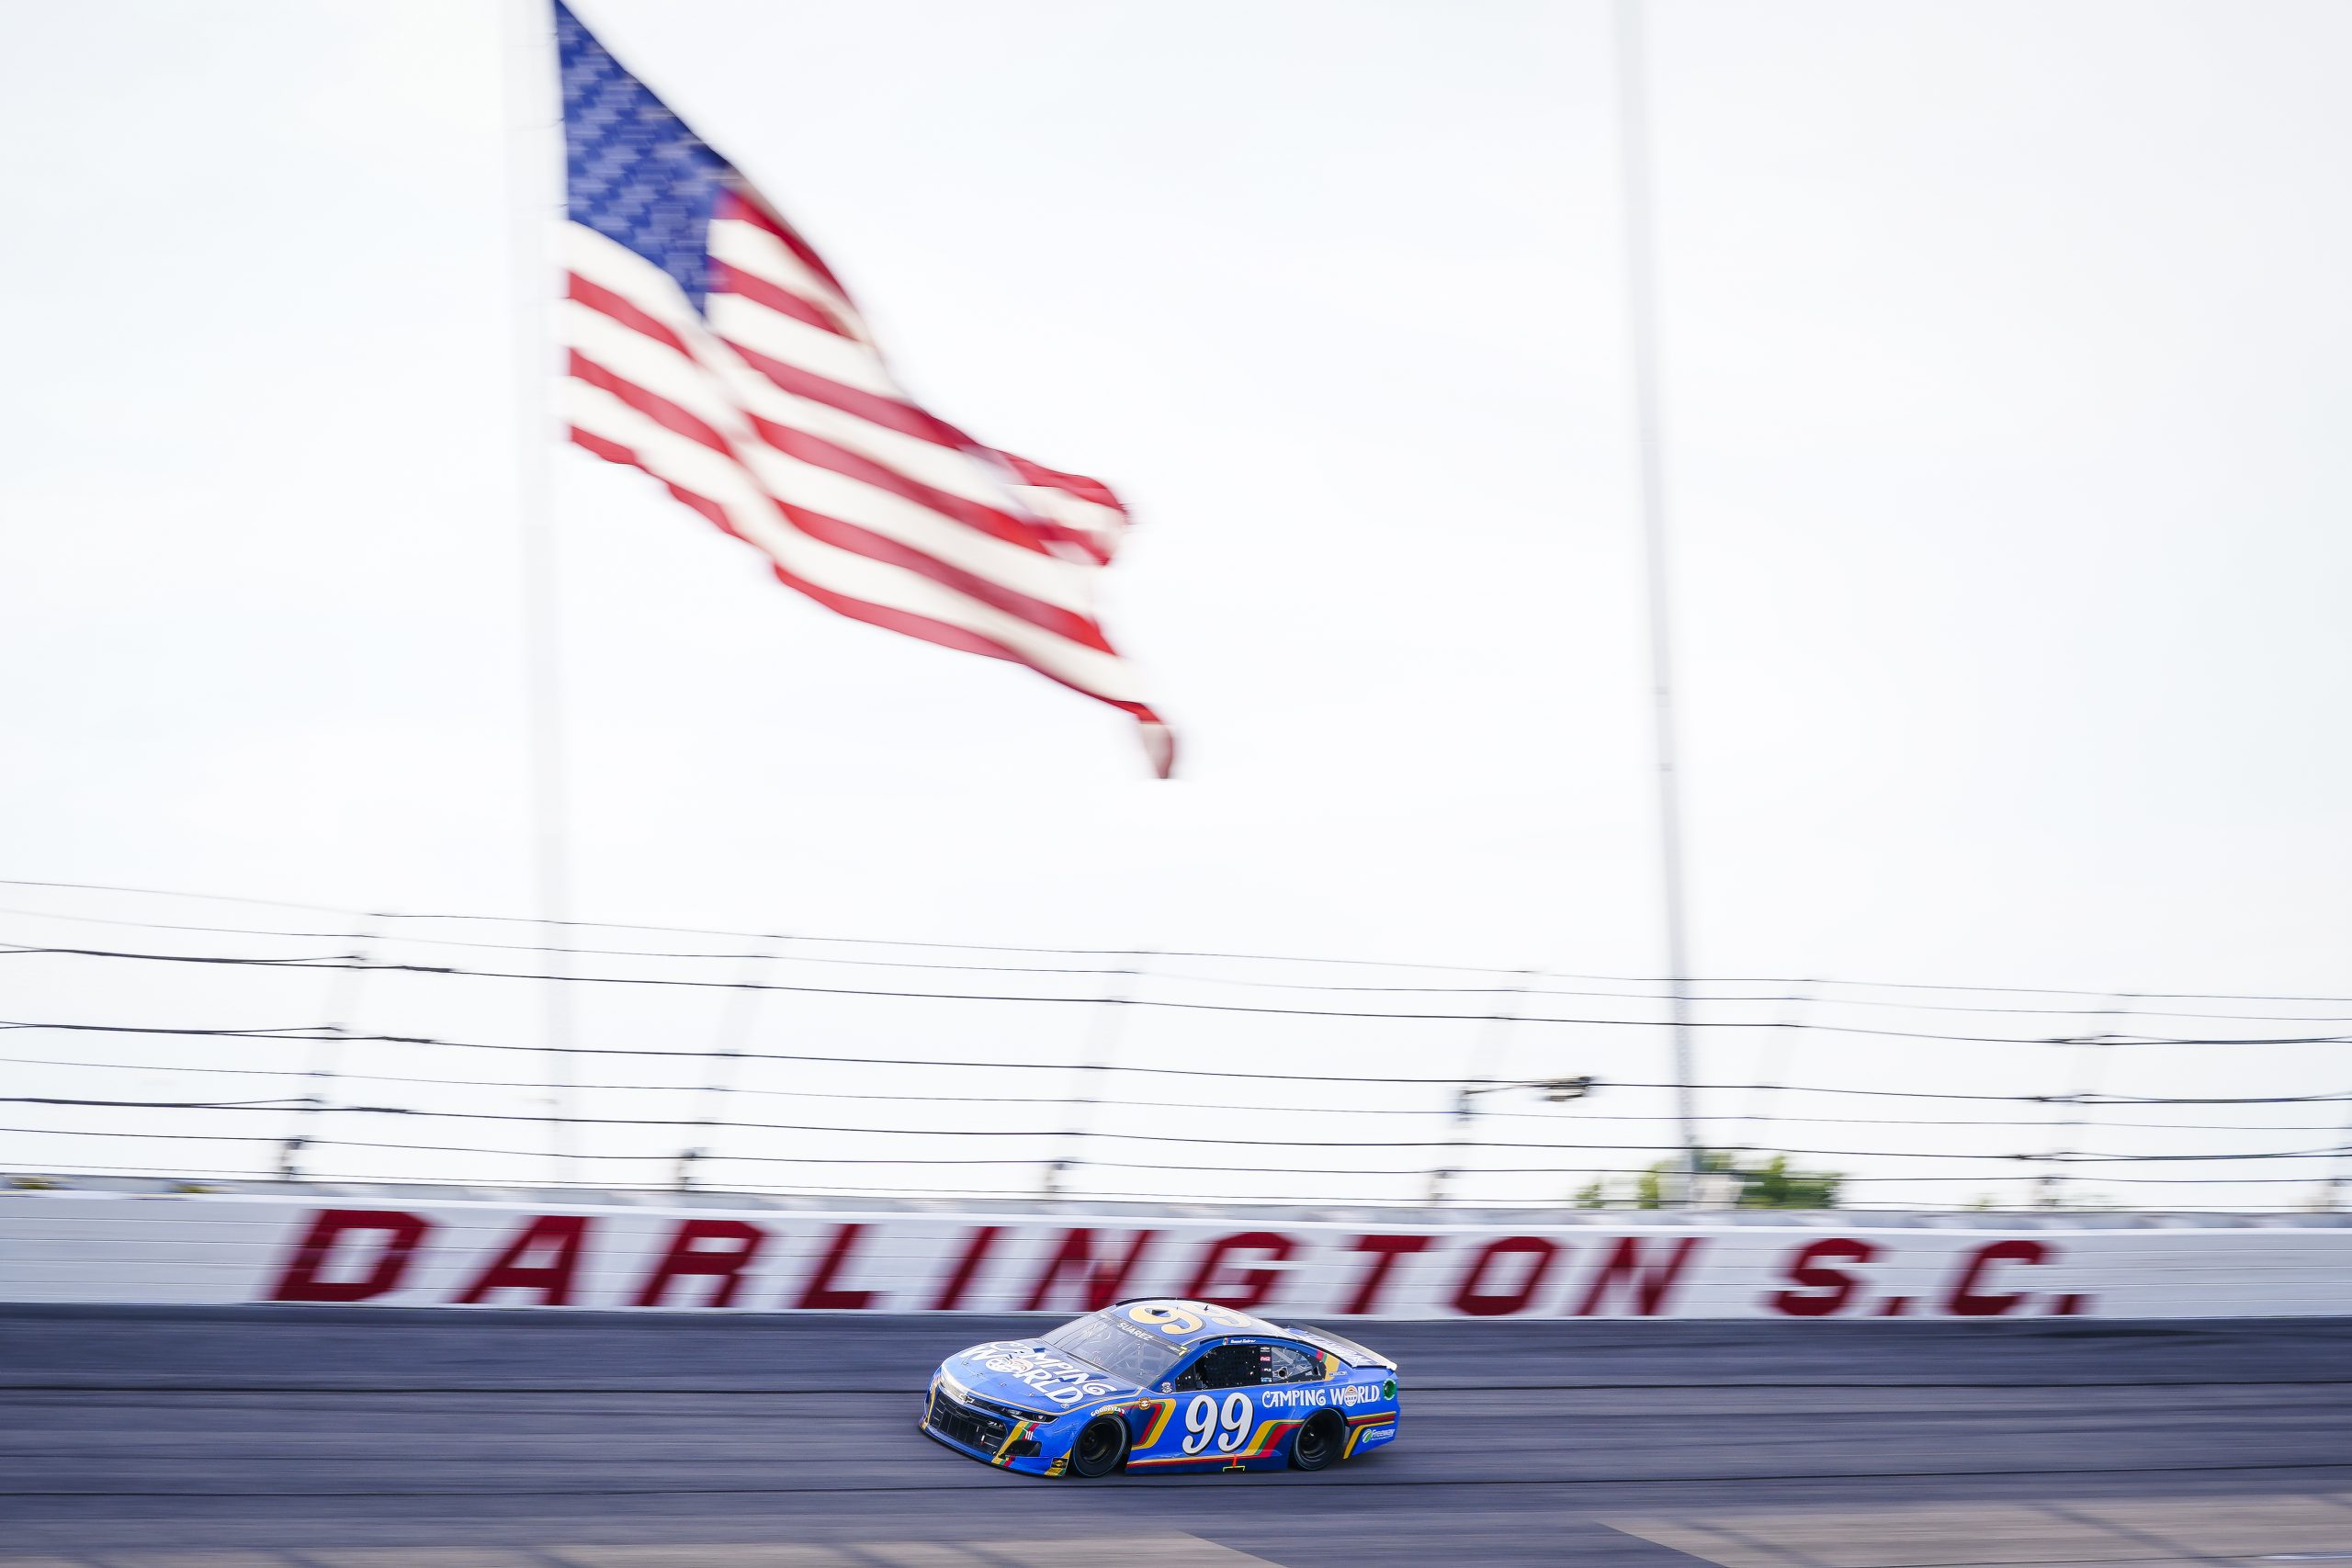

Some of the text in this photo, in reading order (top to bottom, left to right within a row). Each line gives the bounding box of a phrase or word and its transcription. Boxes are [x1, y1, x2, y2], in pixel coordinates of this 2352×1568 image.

[270, 1208, 2095, 1317] DARLINGTON S.C.
[959, 1345, 1084, 1404] WORLD
[989, 1341, 1118, 1396] CAMPING
[1261, 1388, 1327, 1408] CAMPING
[1329, 1385, 1380, 1406] WORLD
[1182, 1392, 1254, 1455] 99
